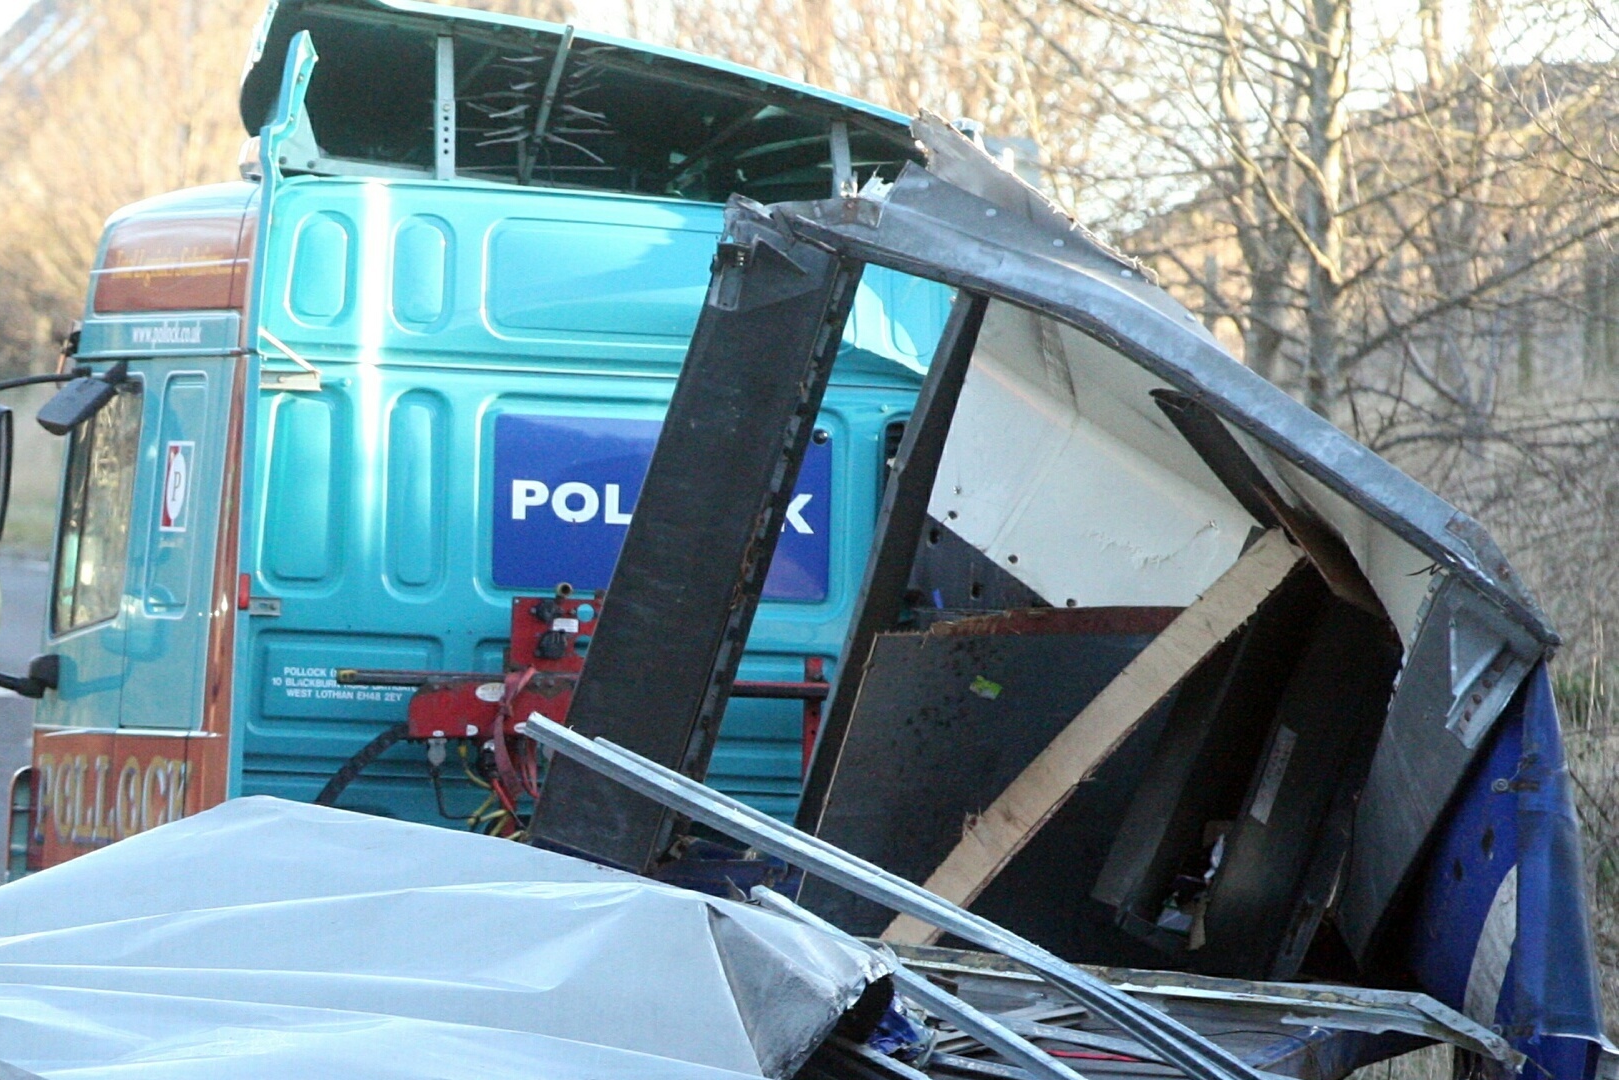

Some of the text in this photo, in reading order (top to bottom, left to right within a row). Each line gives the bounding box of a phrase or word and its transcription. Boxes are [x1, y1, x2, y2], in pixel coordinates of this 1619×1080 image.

[511, 479, 815, 535] POLK
[284, 667, 327, 677] POLLOCK
[272, 677, 282, 686] 10
[286, 688, 312, 698] WEST
[316, 690, 354, 700] LOTHIAN
[385, 692, 402, 702] 2EY
[34, 753, 193, 844] POLLOCK
